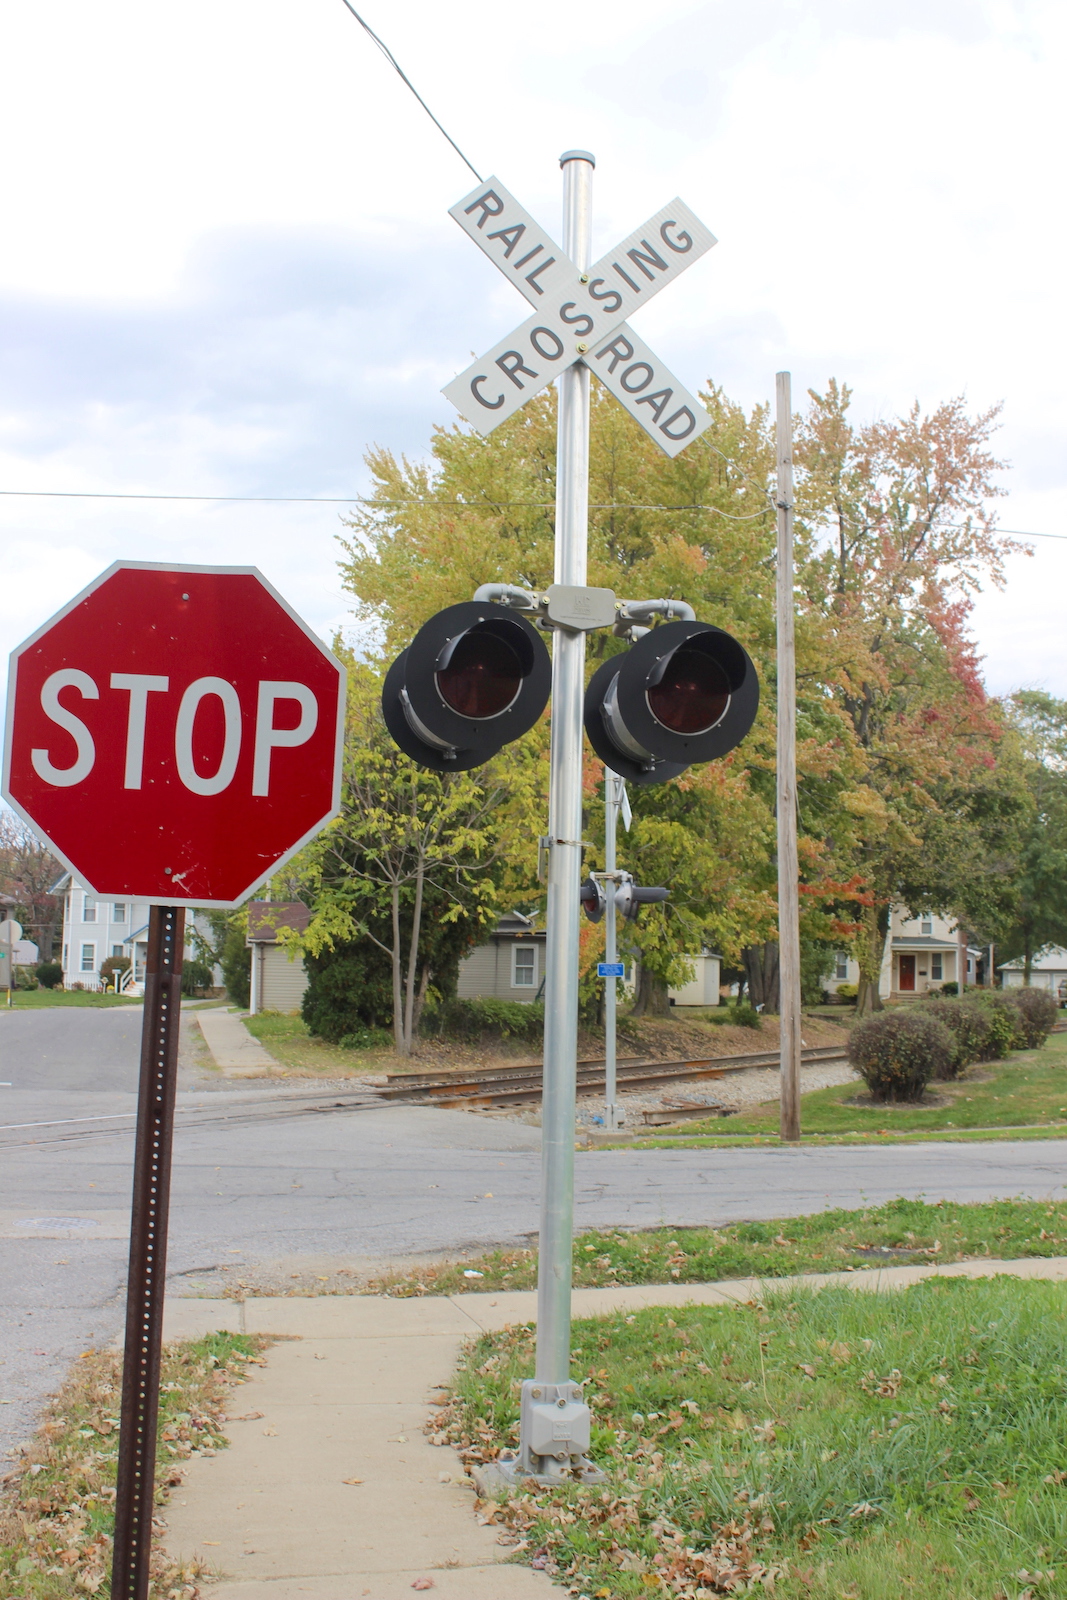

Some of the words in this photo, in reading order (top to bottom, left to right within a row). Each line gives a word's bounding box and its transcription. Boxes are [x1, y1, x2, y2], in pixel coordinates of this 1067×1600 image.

[464, 189, 556, 295] RAIL
[594, 334, 696, 441] ROAD
[470, 220, 694, 410] CROSSING
[31, 668, 318, 797] STOP
